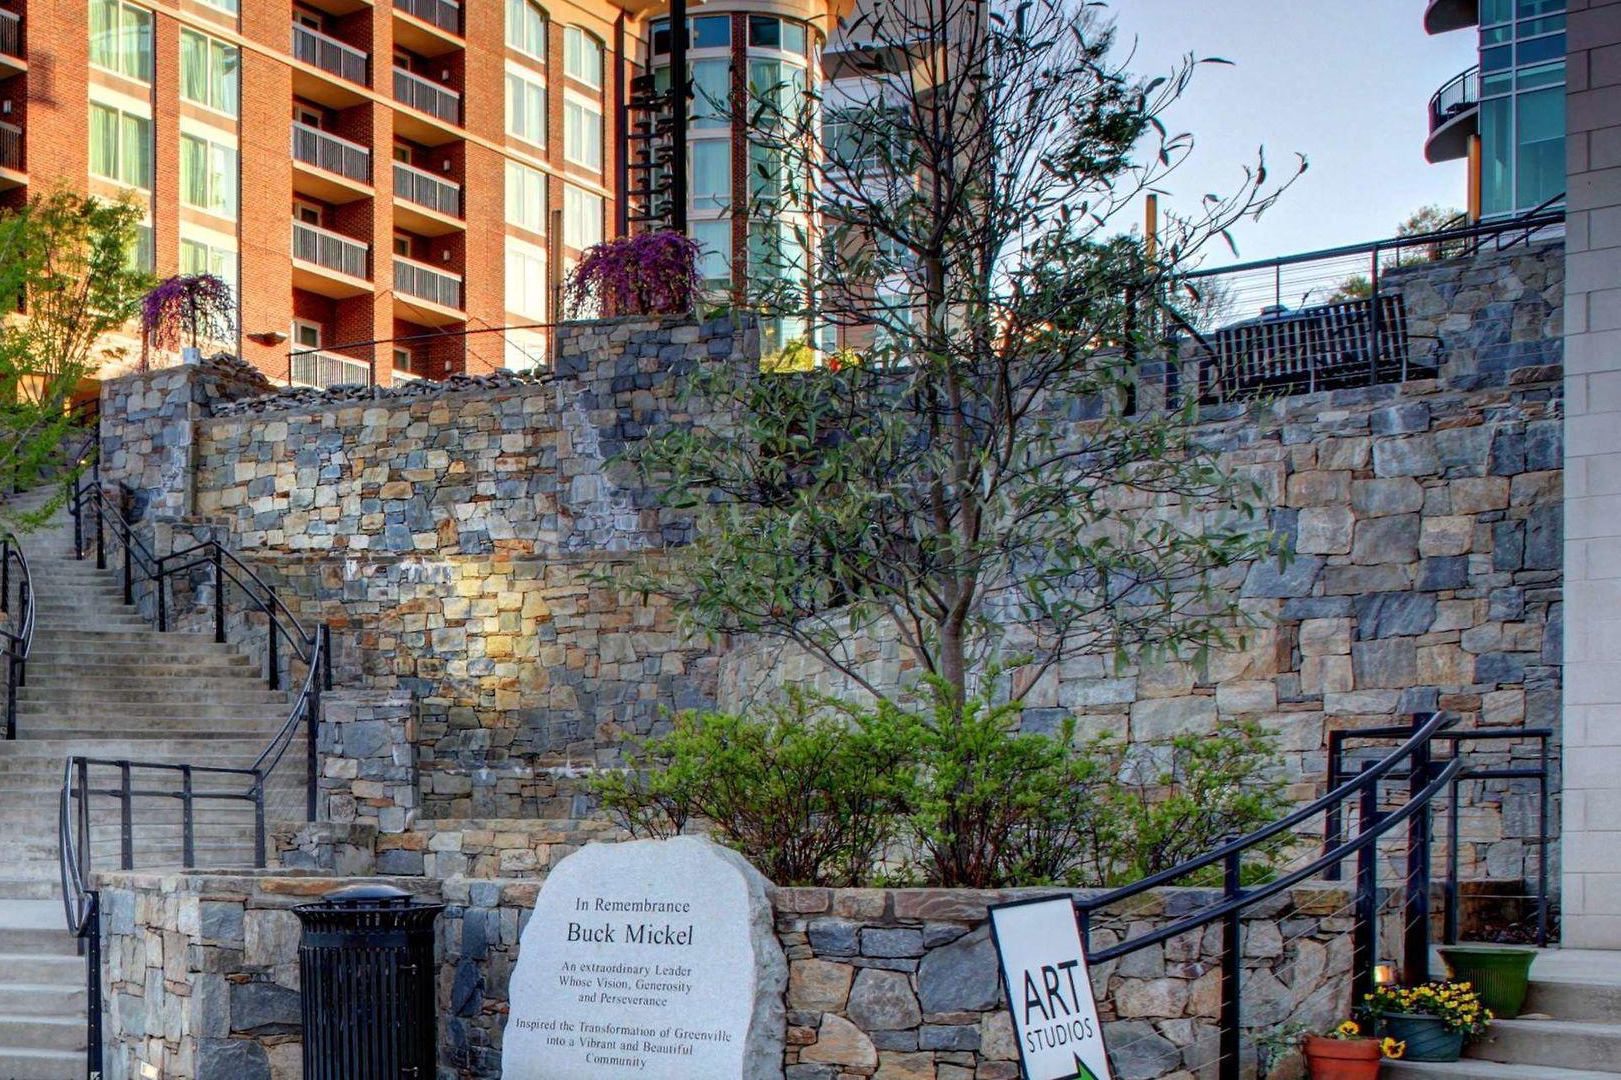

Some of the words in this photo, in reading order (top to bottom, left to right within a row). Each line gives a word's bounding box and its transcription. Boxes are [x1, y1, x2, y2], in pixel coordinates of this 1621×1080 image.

[575, 897, 589, 911] In
[595, 897, 691, 913] Remembrance
[567, 922, 616, 943] Buck
[625, 923, 694, 945] Mickel
[562, 961, 577, 972] An
[580, 962, 651, 978] extraordinary
[655, 965, 692, 977] Leader
[559, 975, 592, 988] Whose
[635, 979, 692, 995] Generosity
[1024, 959, 1080, 1025] ART
[578, 992, 597, 1003] and
[600, 992, 668, 1007] Perseverance
[516, 1018, 556, 1031] Inspired
[559, 1020, 575, 1032] the
[578, 1021, 656, 1037] Transformation
[659, 1026, 672, 1038] of
[674, 1027, 732, 1042] Greenville
[1026, 1018, 1093, 1053] STUDIOS
[546, 1035, 566, 1046] into
[579, 1036, 616, 1050] Vibrant
[619, 1040, 639, 1051] and
[643, 1041, 693, 1055] Beautiful
[585, 1052, 646, 1070] Community
